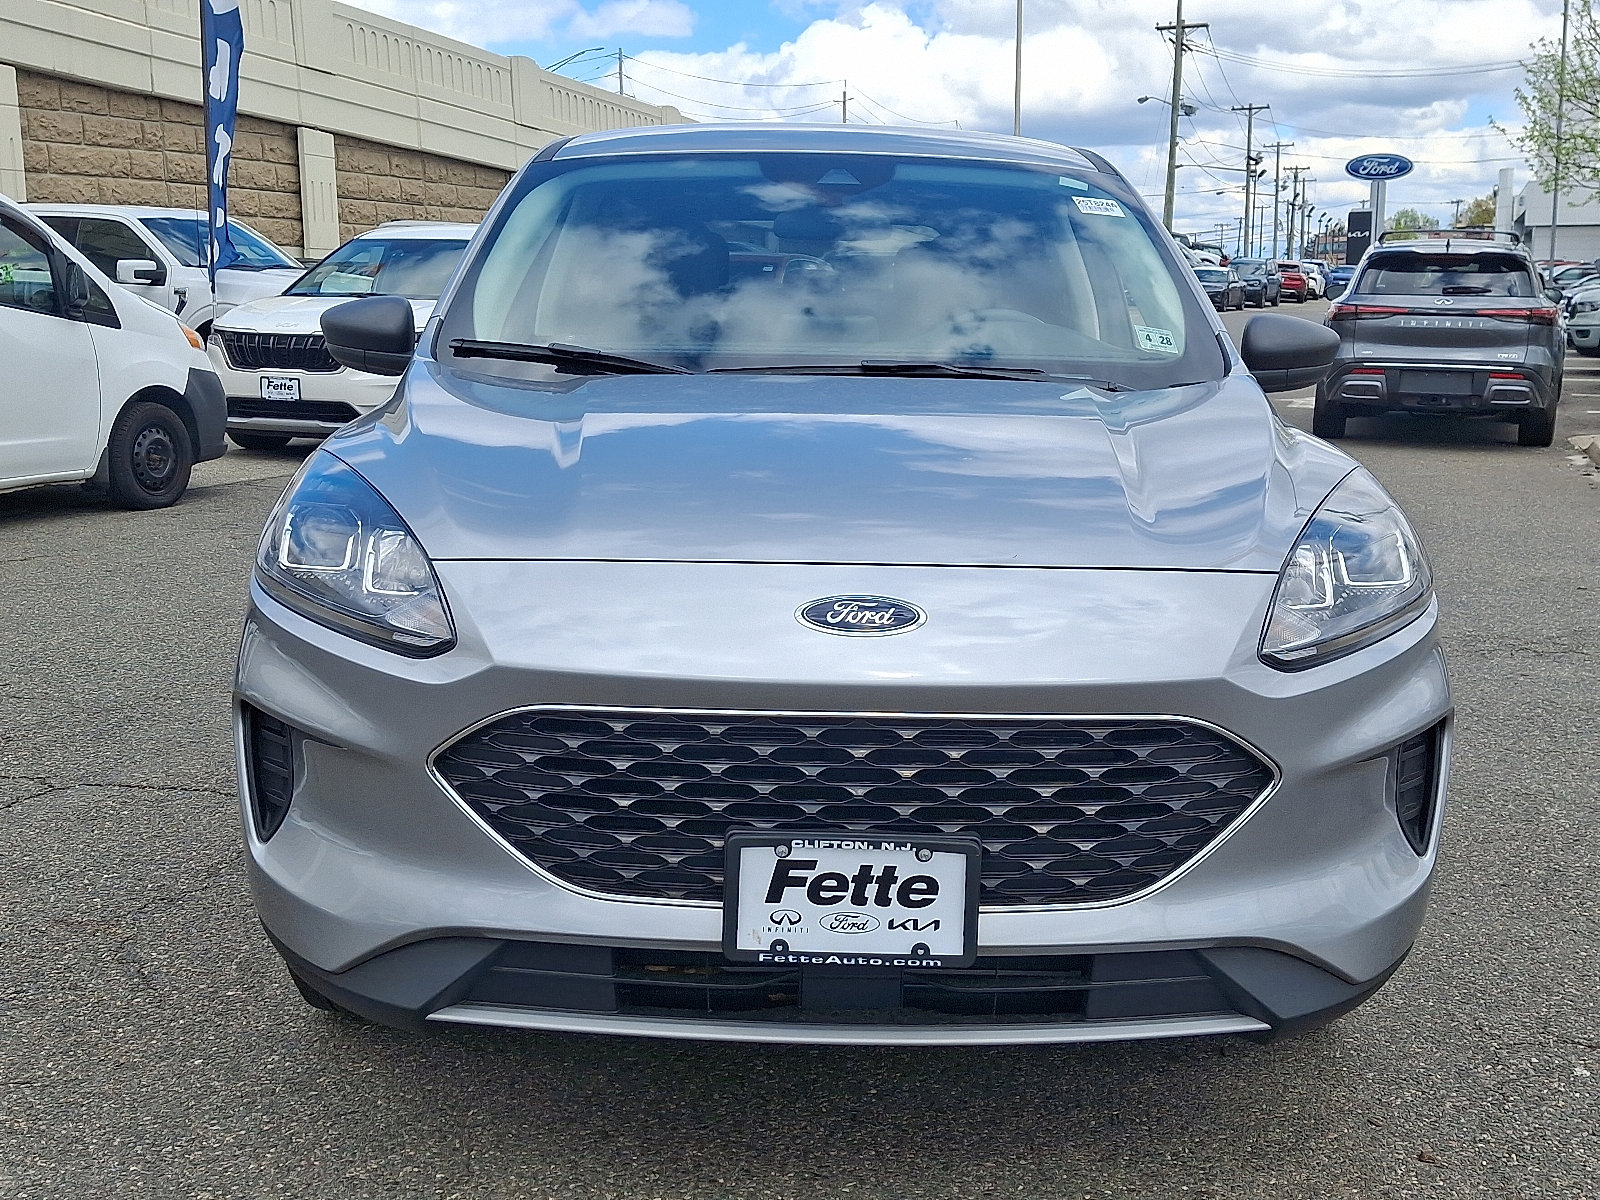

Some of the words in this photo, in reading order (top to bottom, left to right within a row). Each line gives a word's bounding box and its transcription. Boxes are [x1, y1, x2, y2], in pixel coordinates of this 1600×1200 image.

[1359, 158, 1400, 174] Ford
[1400, 319, 1484, 328] INFINITI
[1145, 333, 1153, 342] 4
[1158, 335, 1173, 346] 28
[266, 380, 294, 391] Fette
[826, 601, 896, 625] Ford
[881, 842, 917, 852] N.J.
[764, 858, 940, 909] Fette
[830, 914, 870, 931] Ford
[888, 918, 941, 931] KIA
[762, 926, 809, 934] INFINITI
[758, 953, 942, 967] FetteAuto.com
